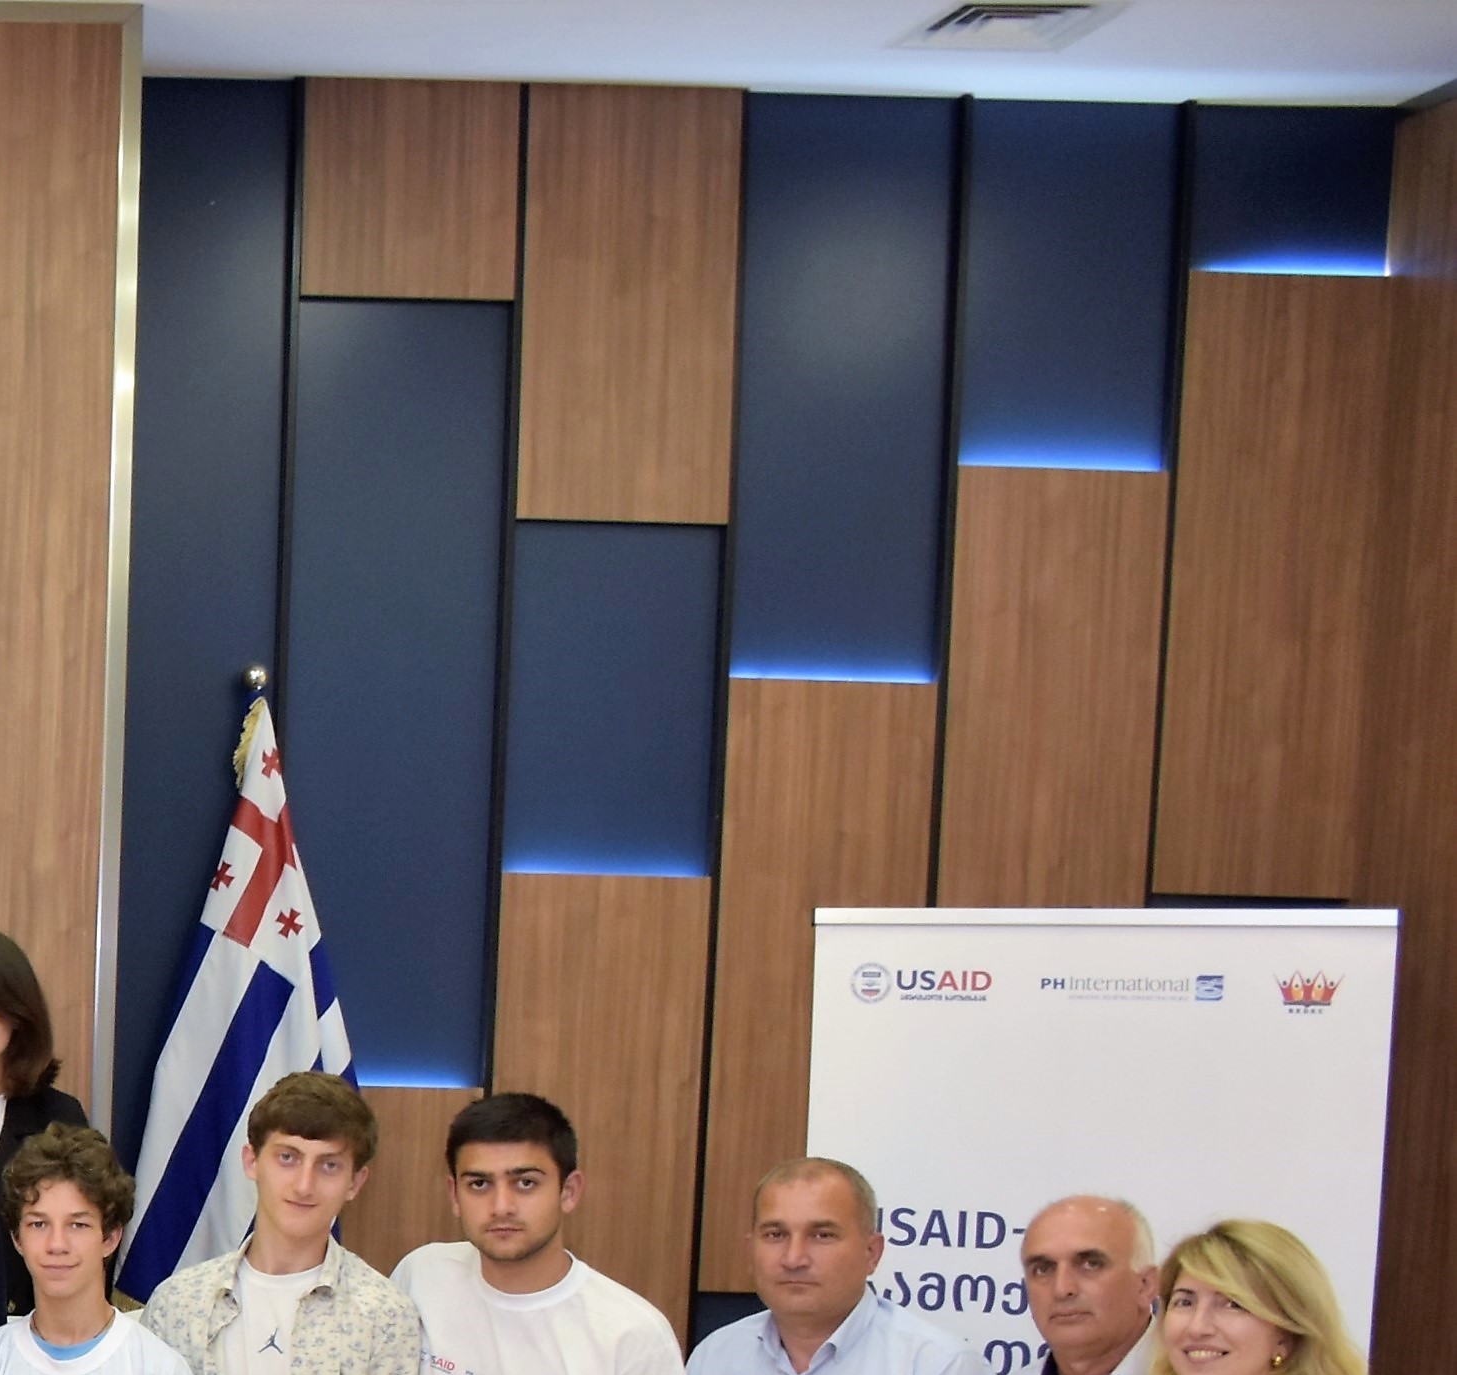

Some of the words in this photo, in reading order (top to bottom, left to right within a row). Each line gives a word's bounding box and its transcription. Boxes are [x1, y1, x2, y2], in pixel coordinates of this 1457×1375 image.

[896, 970, 992, 991] USAID
[1040, 977, 1065, 990] PH
[1068, 976, 1190, 992] International
